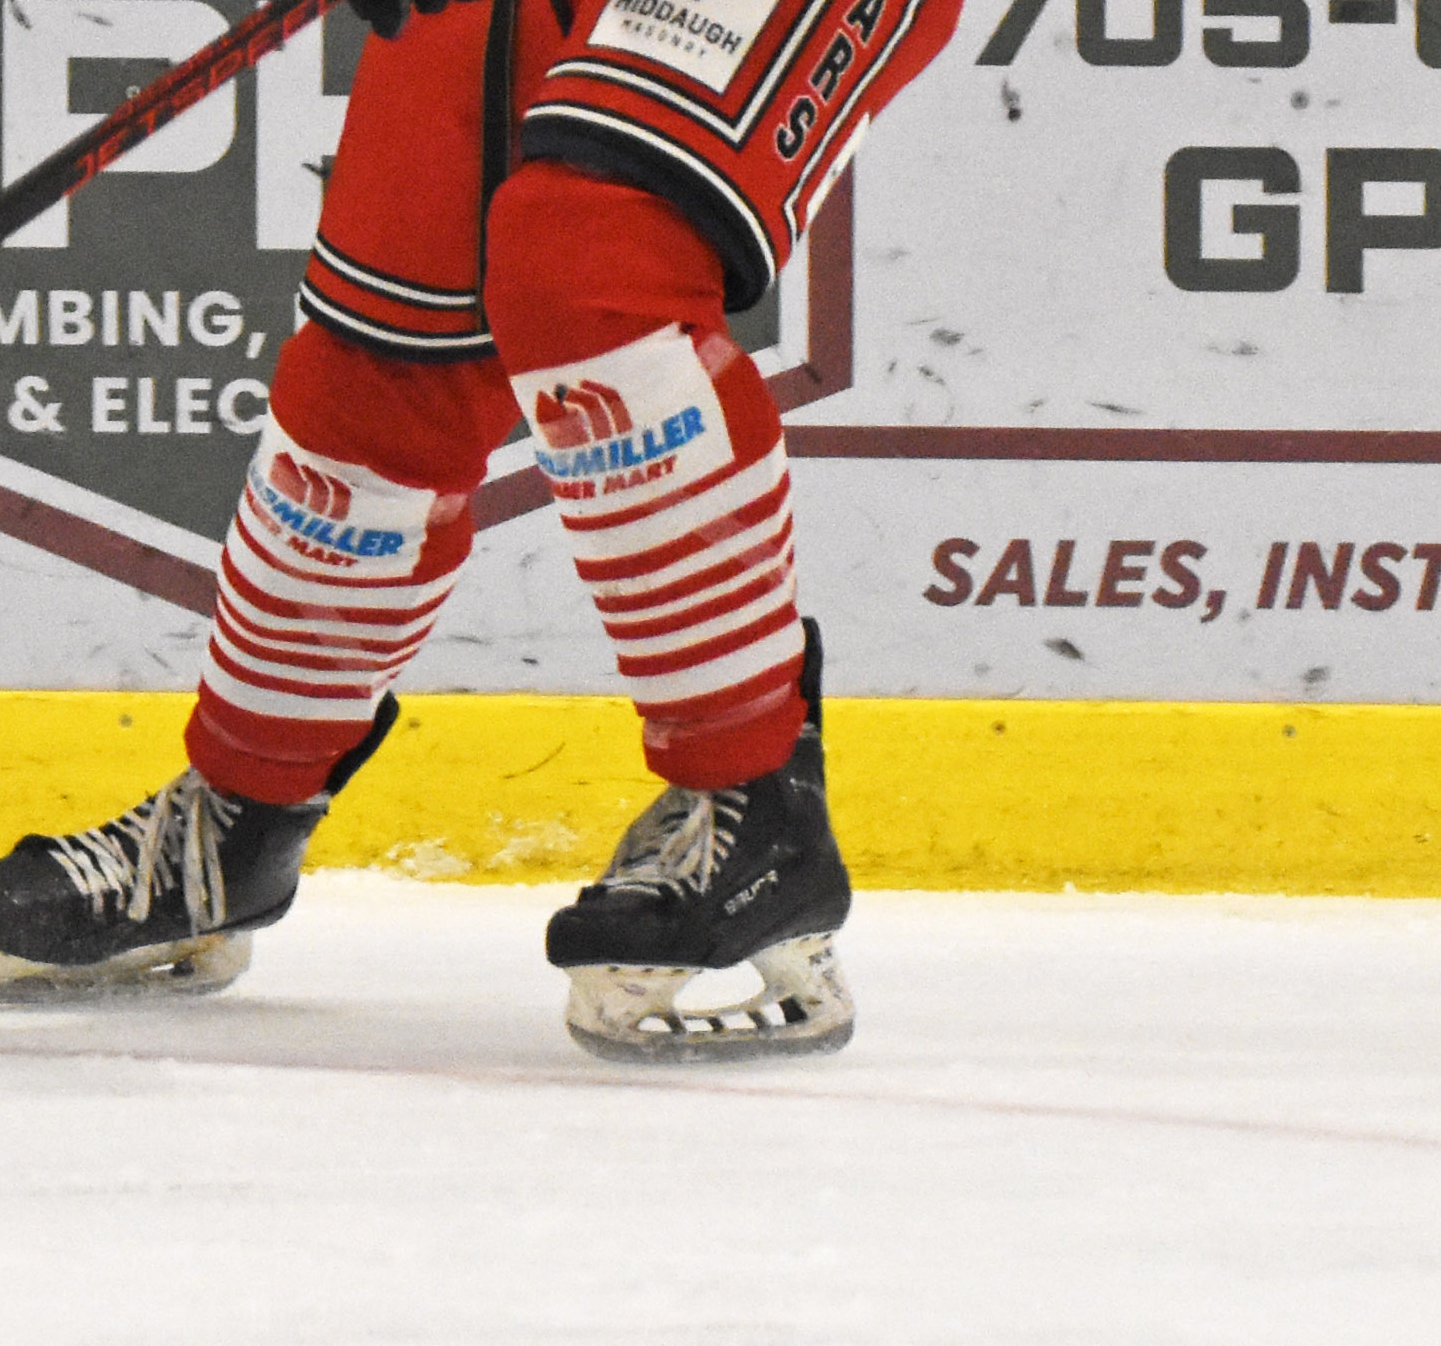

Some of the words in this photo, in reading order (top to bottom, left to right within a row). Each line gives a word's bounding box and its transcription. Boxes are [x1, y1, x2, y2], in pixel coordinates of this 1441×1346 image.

[620, 18, 707, 58] MASONRY
[1164, 147, 1441, 294] GP
[7, 375, 65, 434] &
[91, 376, 270, 435] ELEC
[922, 537, 1228, 624] SALES,
